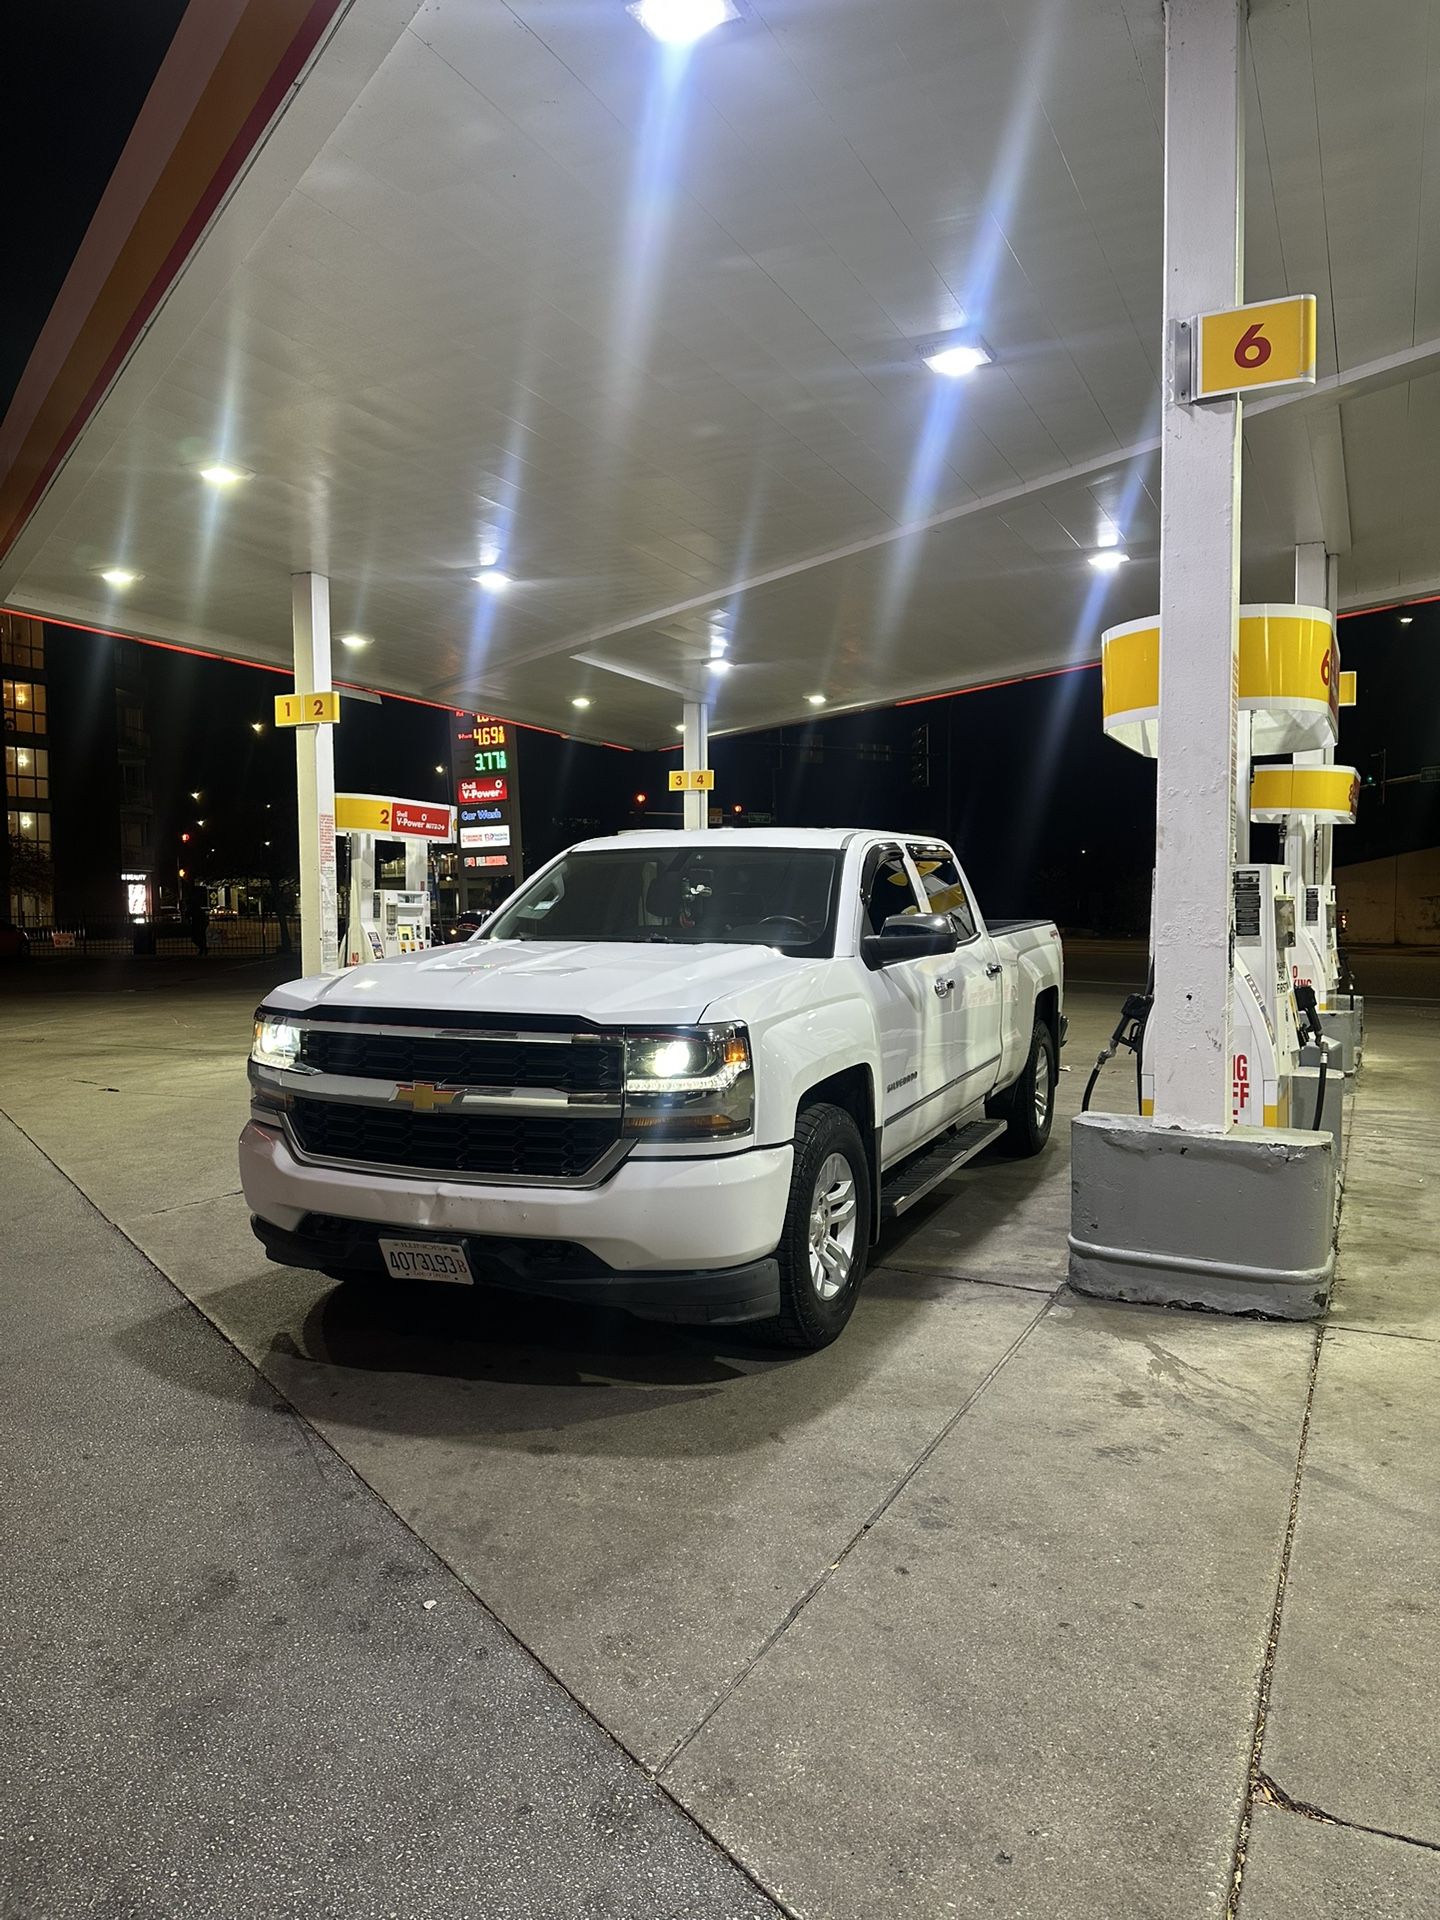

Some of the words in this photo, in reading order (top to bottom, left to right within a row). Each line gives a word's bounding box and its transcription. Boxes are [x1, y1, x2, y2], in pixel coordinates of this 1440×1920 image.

[1233, 322, 1272, 369] 6
[1320, 648, 1330, 687] 6
[285, 702, 292, 717] 1
[313, 699, 324, 717] 2
[461, 781, 477, 790] Shell
[675, 776, 683, 786] 3
[696, 774, 704, 784] 4
[462, 789, 500, 799] V-Power
[380, 809, 390, 825] 2
[461, 810, 477, 821] Car
[477, 808, 502, 820] Wash
[396, 817, 425, 829] V-Power
[886, 1071, 918, 1094] SILVERADO
[390, 1252, 457, 1274] 4073193
